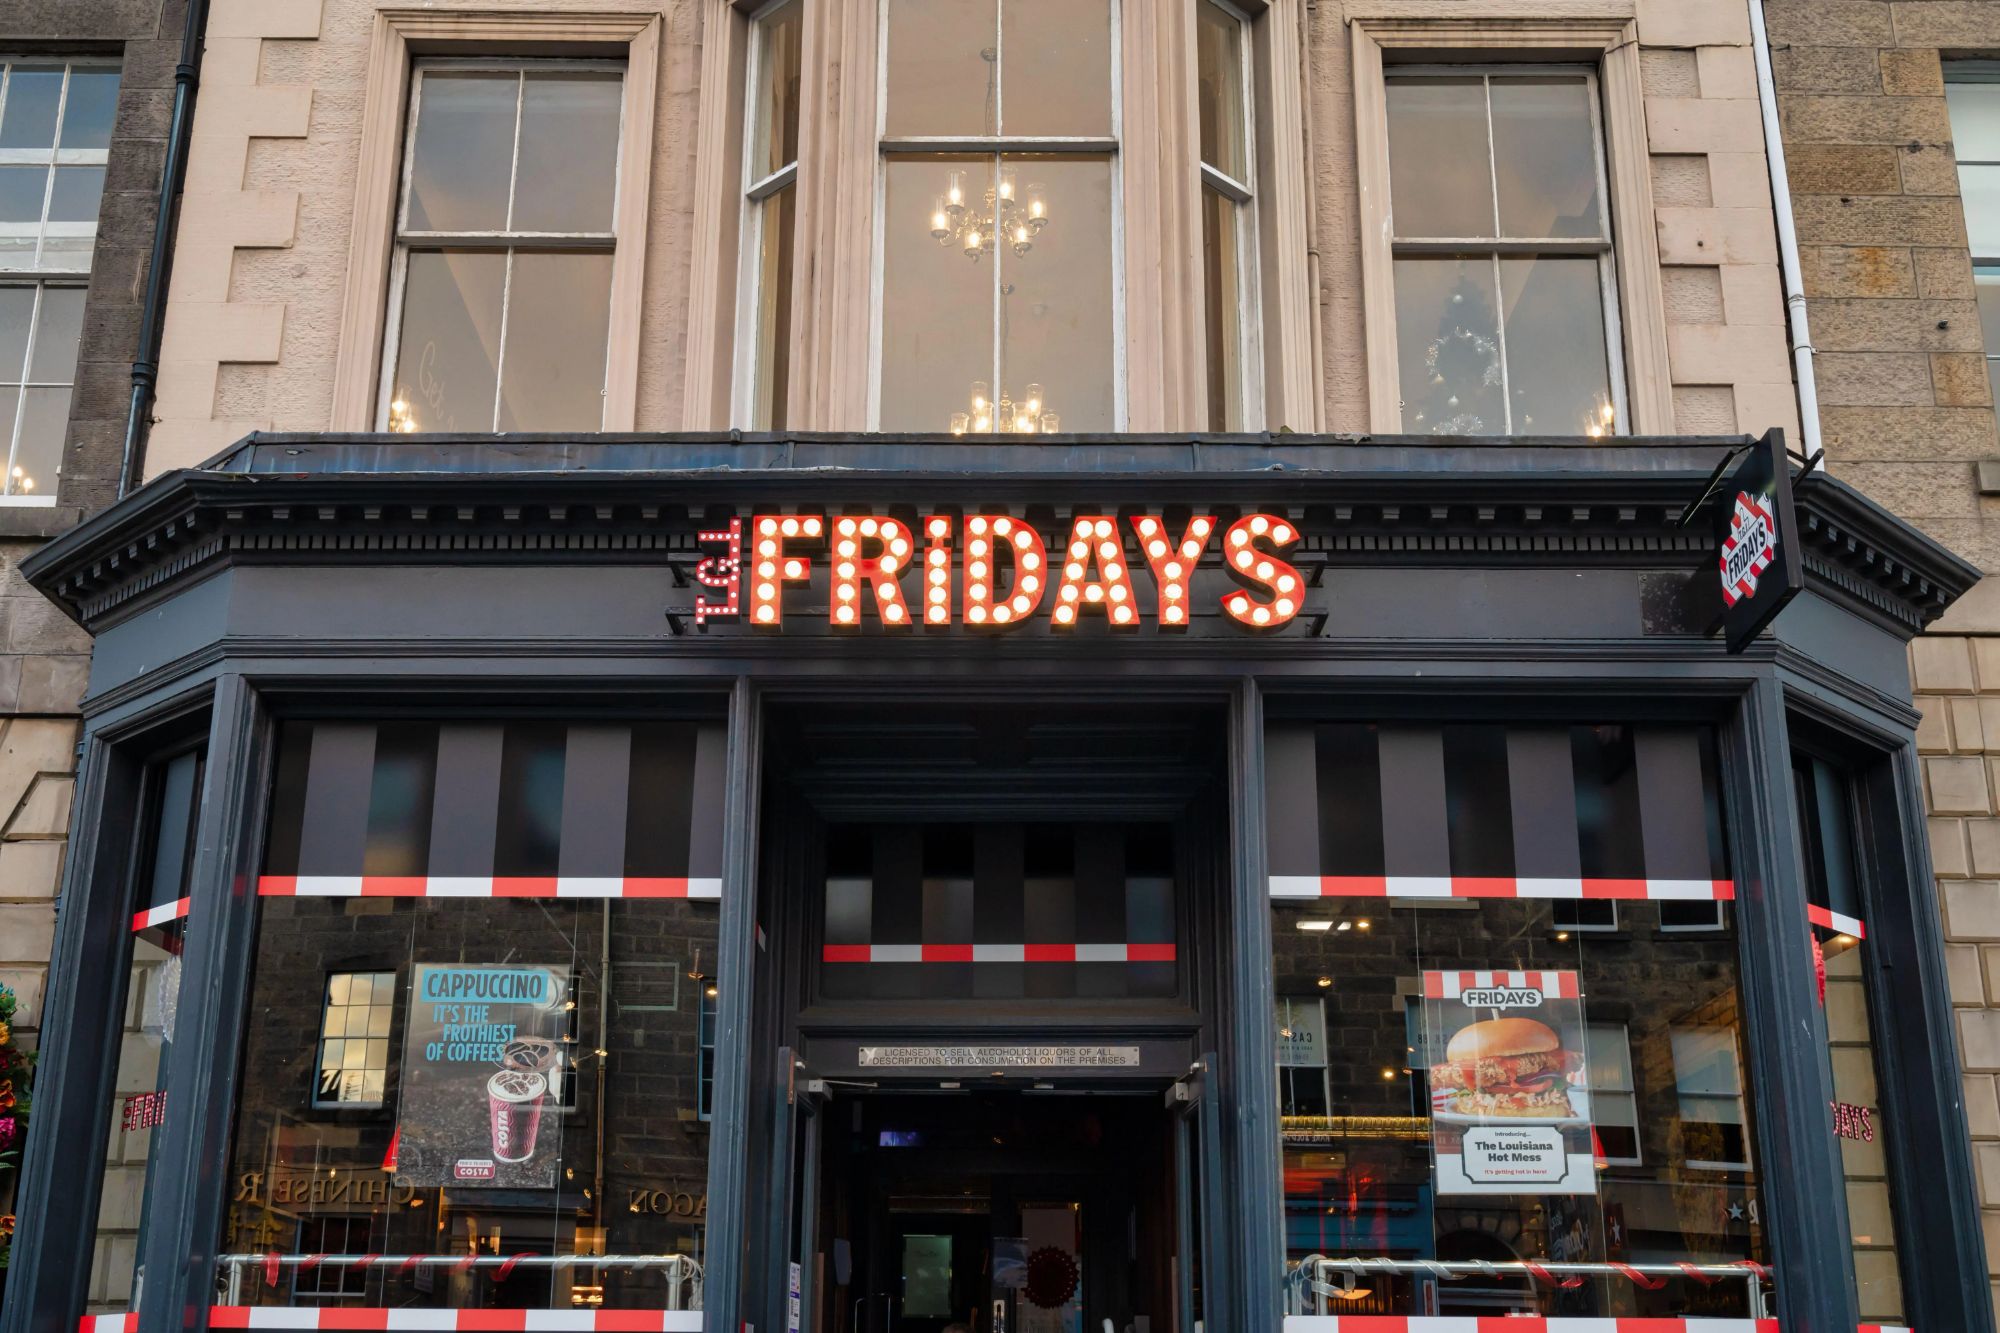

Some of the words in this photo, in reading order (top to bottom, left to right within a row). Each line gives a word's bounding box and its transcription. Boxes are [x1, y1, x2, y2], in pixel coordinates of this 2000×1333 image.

[695, 517, 741, 626] TGI
[427, 973, 542, 999] CAPPUCCINO
[1467, 991, 1537, 1005] FRIDAYS
[433, 1004, 460, 1024] IT'S
[464, 1005, 490, 1024] THE
[443, 1024, 517, 1044] FROTHIEST
[426, 1042, 445, 1061] OF
[447, 1043, 505, 1062] COFFEES
[872, 1056, 942, 1065] DESCRIPTIONS
[945, 1056, 964, 1065] FOR
[967, 1056, 1037, 1065] CONSUMPTION
[1040, 1056, 1054, 1065] ON
[1056, 1056, 1076, 1065] THE
[1080, 1056, 1126, 1065] PREMISES
[884, 1048, 931, 1057] LICENSED
[935, 1048, 947, 1057] TO
[951, 1048, 974, 1057] SELL
[977, 1048, 1031, 1057] ALCOHOLIC
[1034, 1048, 1076, 1057] LIQUORS
[1079, 1048, 1092, 1057] OF
[1096, 1048, 1113, 1057] ALL
[497, 1110, 509, 1148] COSTA
[1475, 1141, 1497, 1151] The
[1498, 1141, 1553, 1151] Louisiana
[1488, 1153, 1509, 1162] Hot
[1511, 1153, 1542, 1162] Mess
[459, 1167, 489, 1177] COSTA
